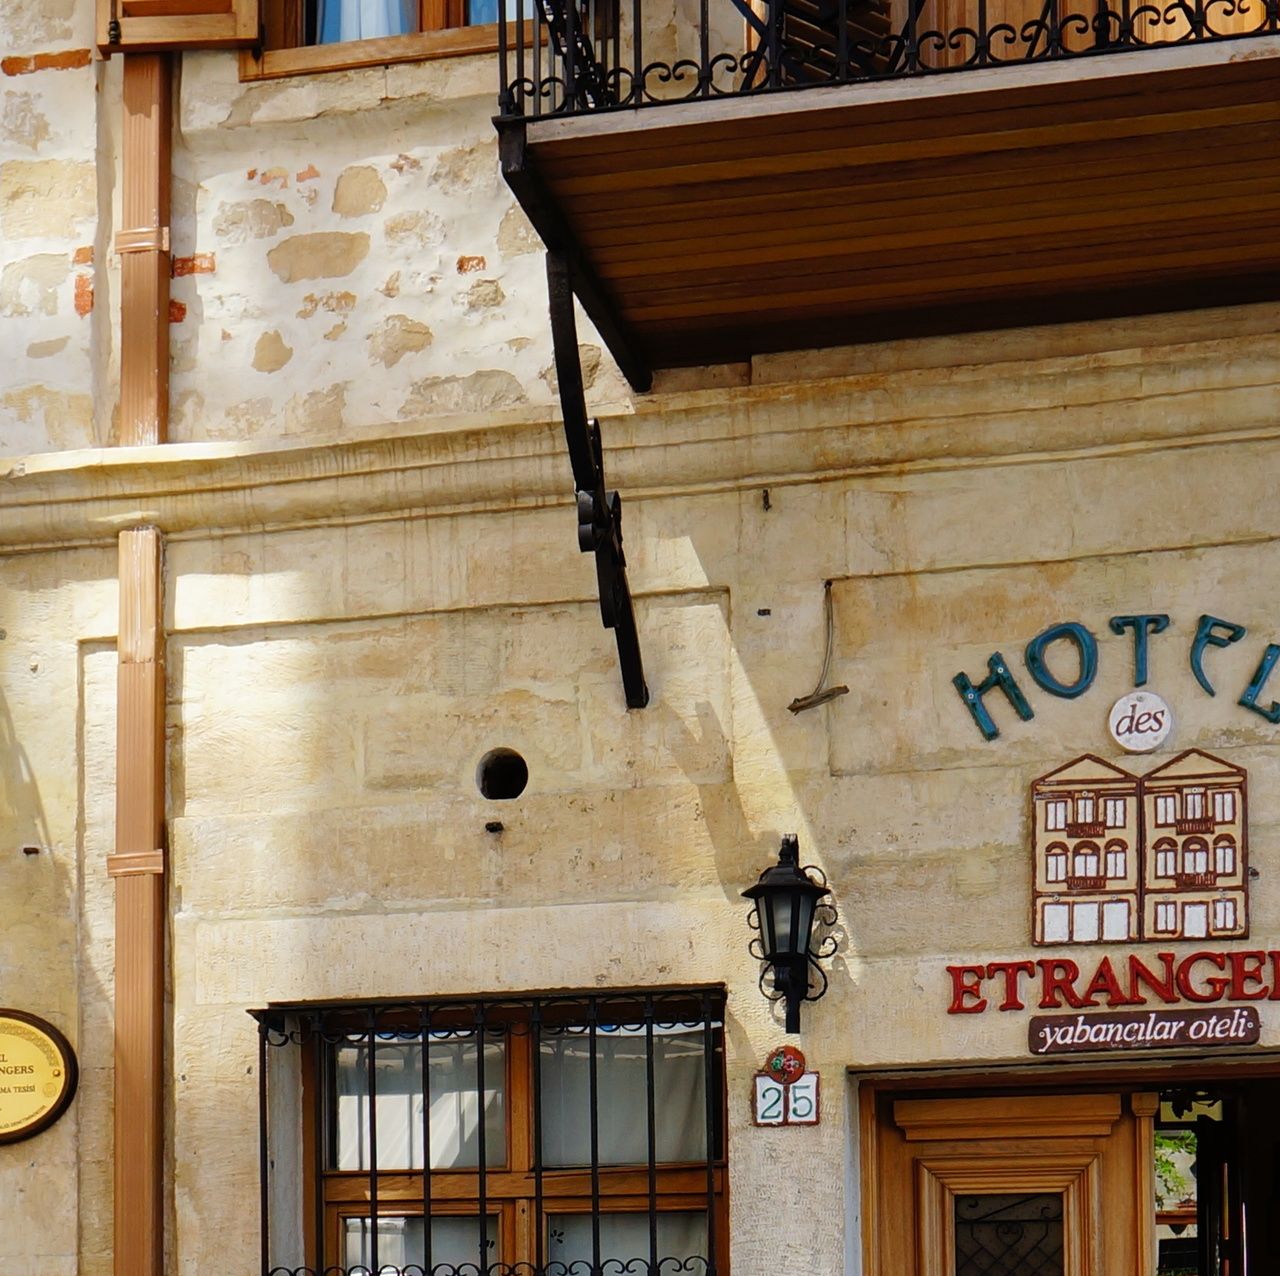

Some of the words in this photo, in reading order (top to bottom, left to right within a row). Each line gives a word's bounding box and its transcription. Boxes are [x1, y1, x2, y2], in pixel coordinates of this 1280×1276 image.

[1115, 703, 1167, 737] des
[1038, 1012, 1185, 1053] yabancılar
[1188, 1009, 1248, 1039] oteli
[760, 1084, 814, 1120] 25
